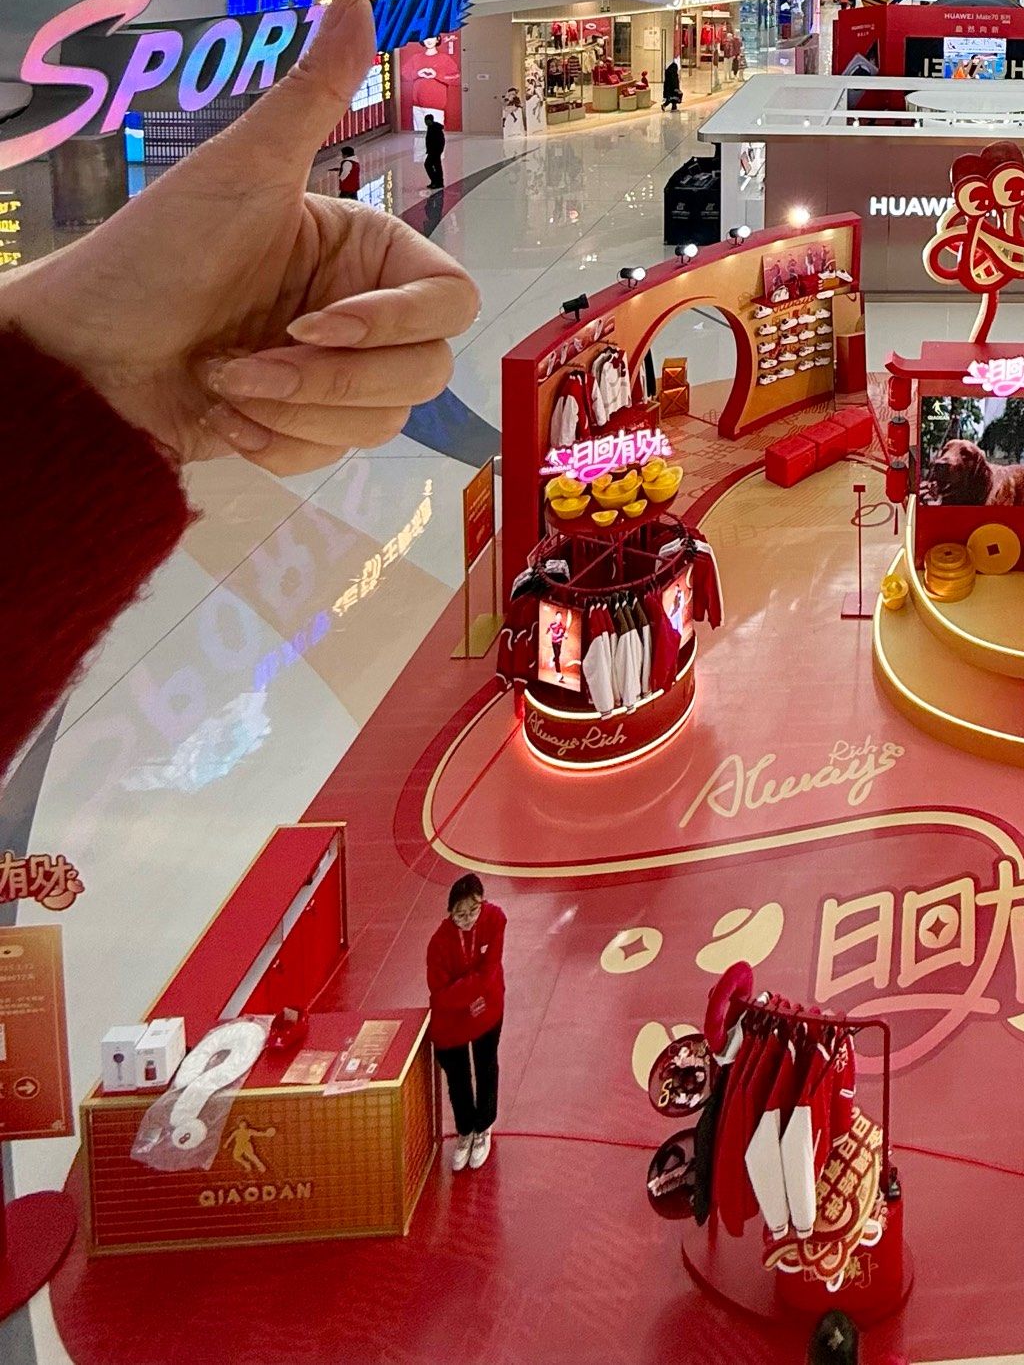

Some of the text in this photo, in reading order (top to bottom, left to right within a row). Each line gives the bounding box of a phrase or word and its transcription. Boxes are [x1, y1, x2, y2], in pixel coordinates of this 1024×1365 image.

[869, 196, 957, 216] HUAW
[527, 710, 627, 751] Always Rich
[829, 735, 879, 765] Rich
[199, 1182, 313, 1207] QIAODAN
